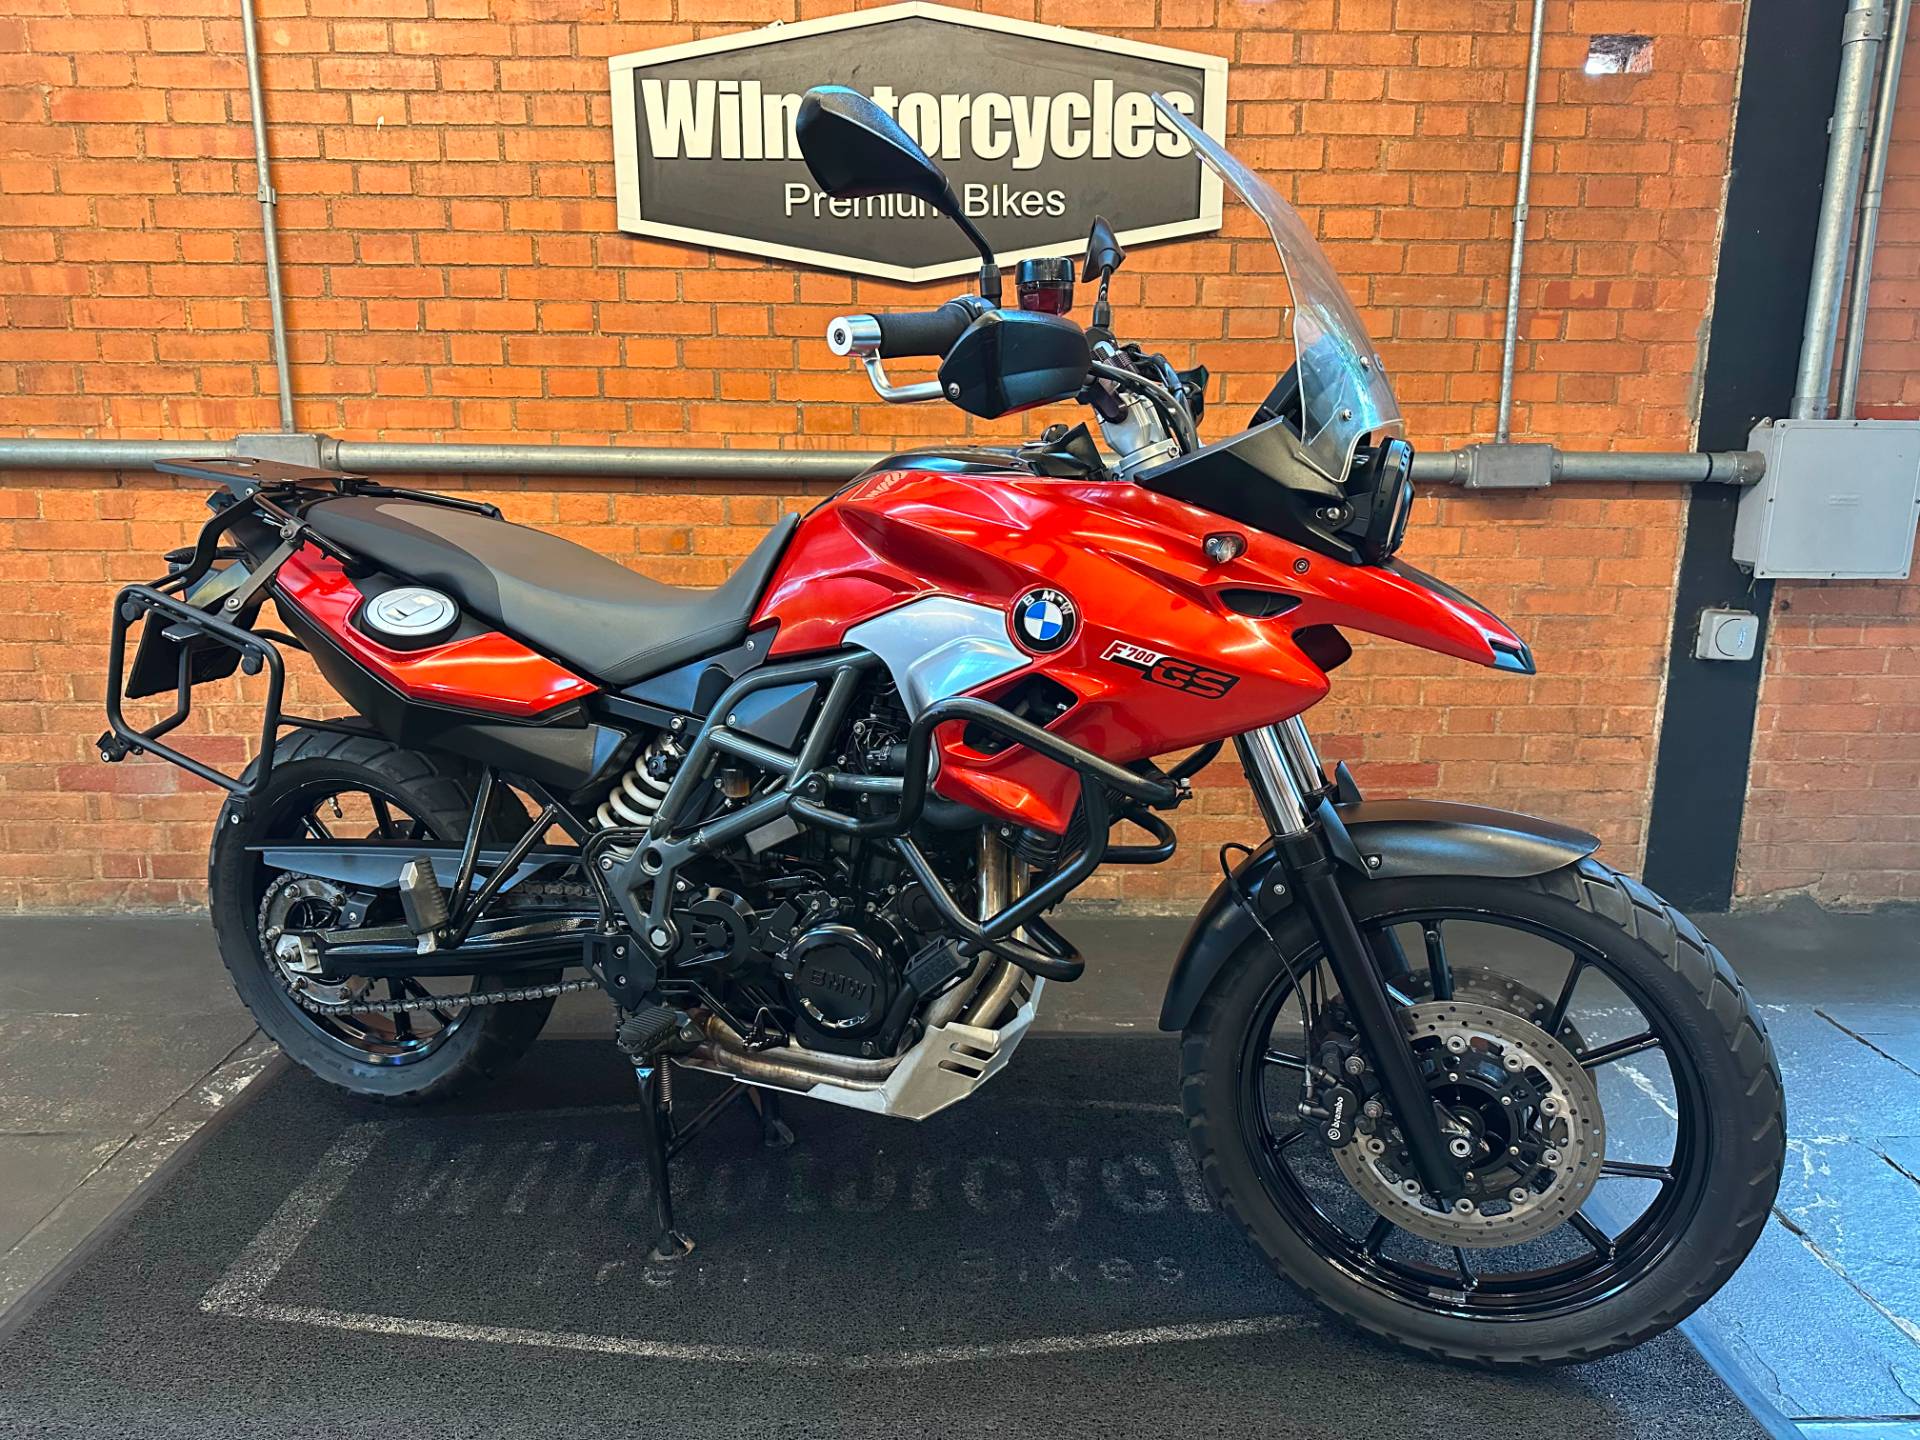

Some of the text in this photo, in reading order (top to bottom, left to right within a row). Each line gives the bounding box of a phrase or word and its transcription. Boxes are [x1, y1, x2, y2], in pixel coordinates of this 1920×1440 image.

[641, 79, 1195, 169] Wilmorcycles
[1023, 590, 1074, 616] BMW
[1151, 660, 1232, 698] GS
[809, 969, 866, 1000] BMW
[1331, 1096, 1344, 1129] brembo
